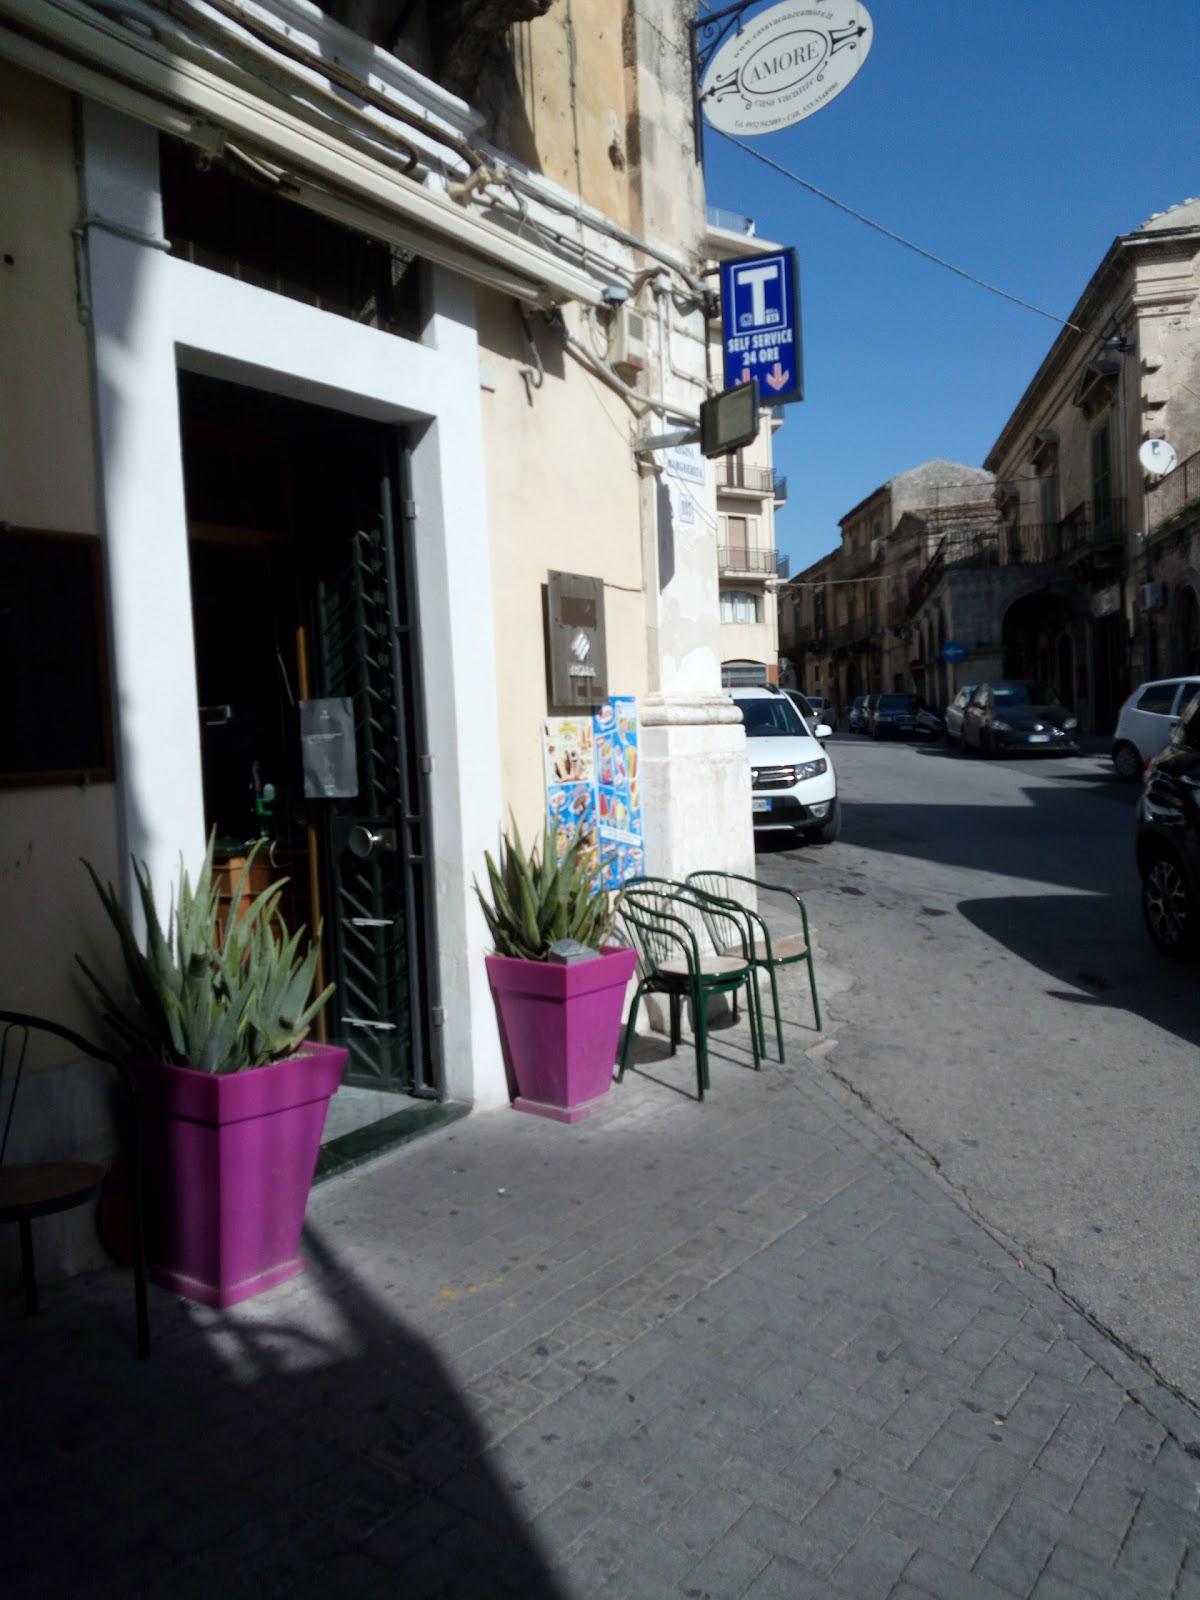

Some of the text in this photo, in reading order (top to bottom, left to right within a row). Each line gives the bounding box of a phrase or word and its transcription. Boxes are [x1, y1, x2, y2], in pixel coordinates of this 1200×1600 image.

[750, 40, 820, 84] AMORE
[737, 265, 779, 327] T
[728, 328, 793, 353] SELF SERVICE
[742, 346, 780, 366] 24 ORE
